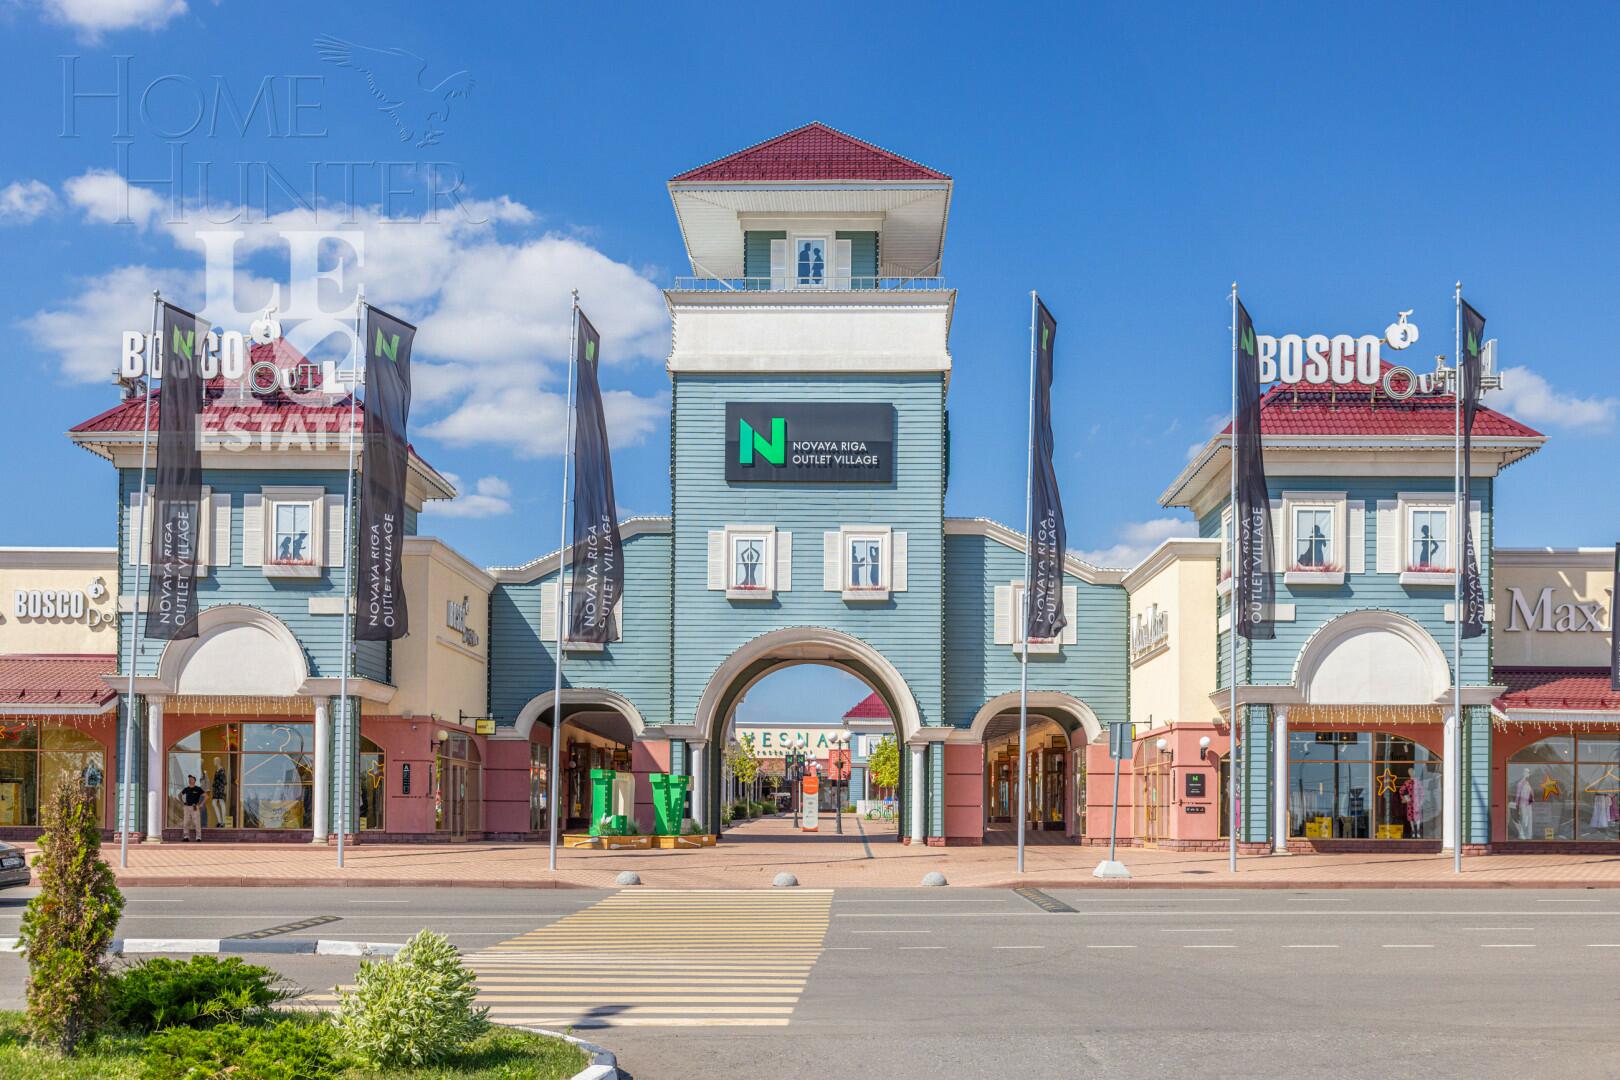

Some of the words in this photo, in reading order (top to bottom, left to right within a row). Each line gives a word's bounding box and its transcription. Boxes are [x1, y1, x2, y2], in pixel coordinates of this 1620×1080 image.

[173, 324, 195, 360] N
[374, 327, 401, 362] N
[1257, 334, 1381, 384] BOSCO
[739, 418, 785, 464] N
[792, 455, 830, 465] OUTLET
[834, 455, 878, 465] VILLAGE
[793, 441, 838, 451] NOVAYA
[841, 441, 867, 451] RIGA
[164, 521, 173, 557] RIGA
[178, 511, 189, 572] VILLAGE
[370, 524, 380, 559] RIGA
[384, 513, 394, 572] VILLAGE
[587, 525, 597, 560] RIGA
[602, 513, 614, 572] VILLAGE
[1038, 519, 1047, 555] RIGA
[1252, 506, 1263, 569] VILLAGE
[15, 590, 84, 618] BOSCO
[160, 562, 172, 624] NOVAYA
[175, 574, 189, 626] OUTLET
[369, 564, 380, 626] NOVAYA
[384, 575, 395, 628] OUTLET
[584, 564, 598, 627] NOVAYA
[1036, 561, 1046, 622] NOVAYA
[1251, 571, 1262, 624] OUTLET
